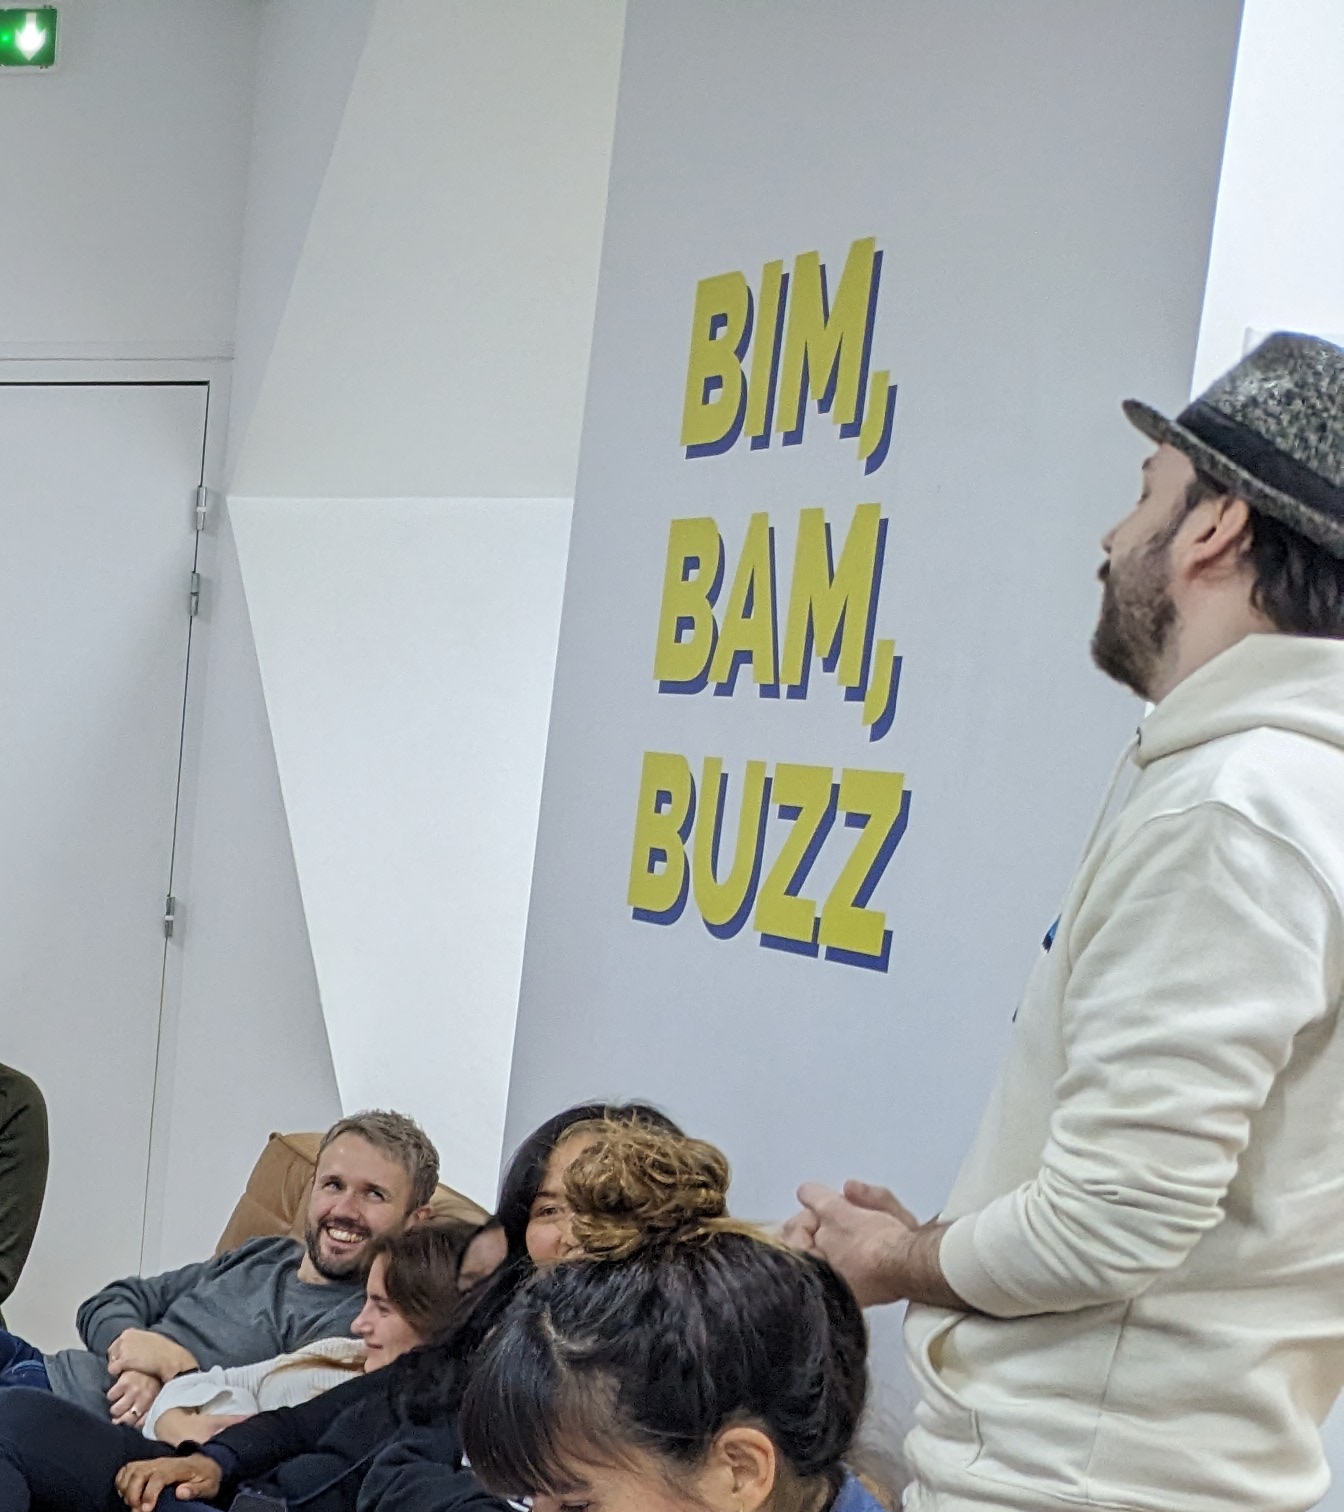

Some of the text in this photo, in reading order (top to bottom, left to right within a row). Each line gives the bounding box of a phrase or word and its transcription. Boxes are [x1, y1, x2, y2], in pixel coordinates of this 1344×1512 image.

[679, 236, 897, 474] BIM,
[653, 503, 903, 742] BAM,
[626, 751, 911, 972] BUZZ
